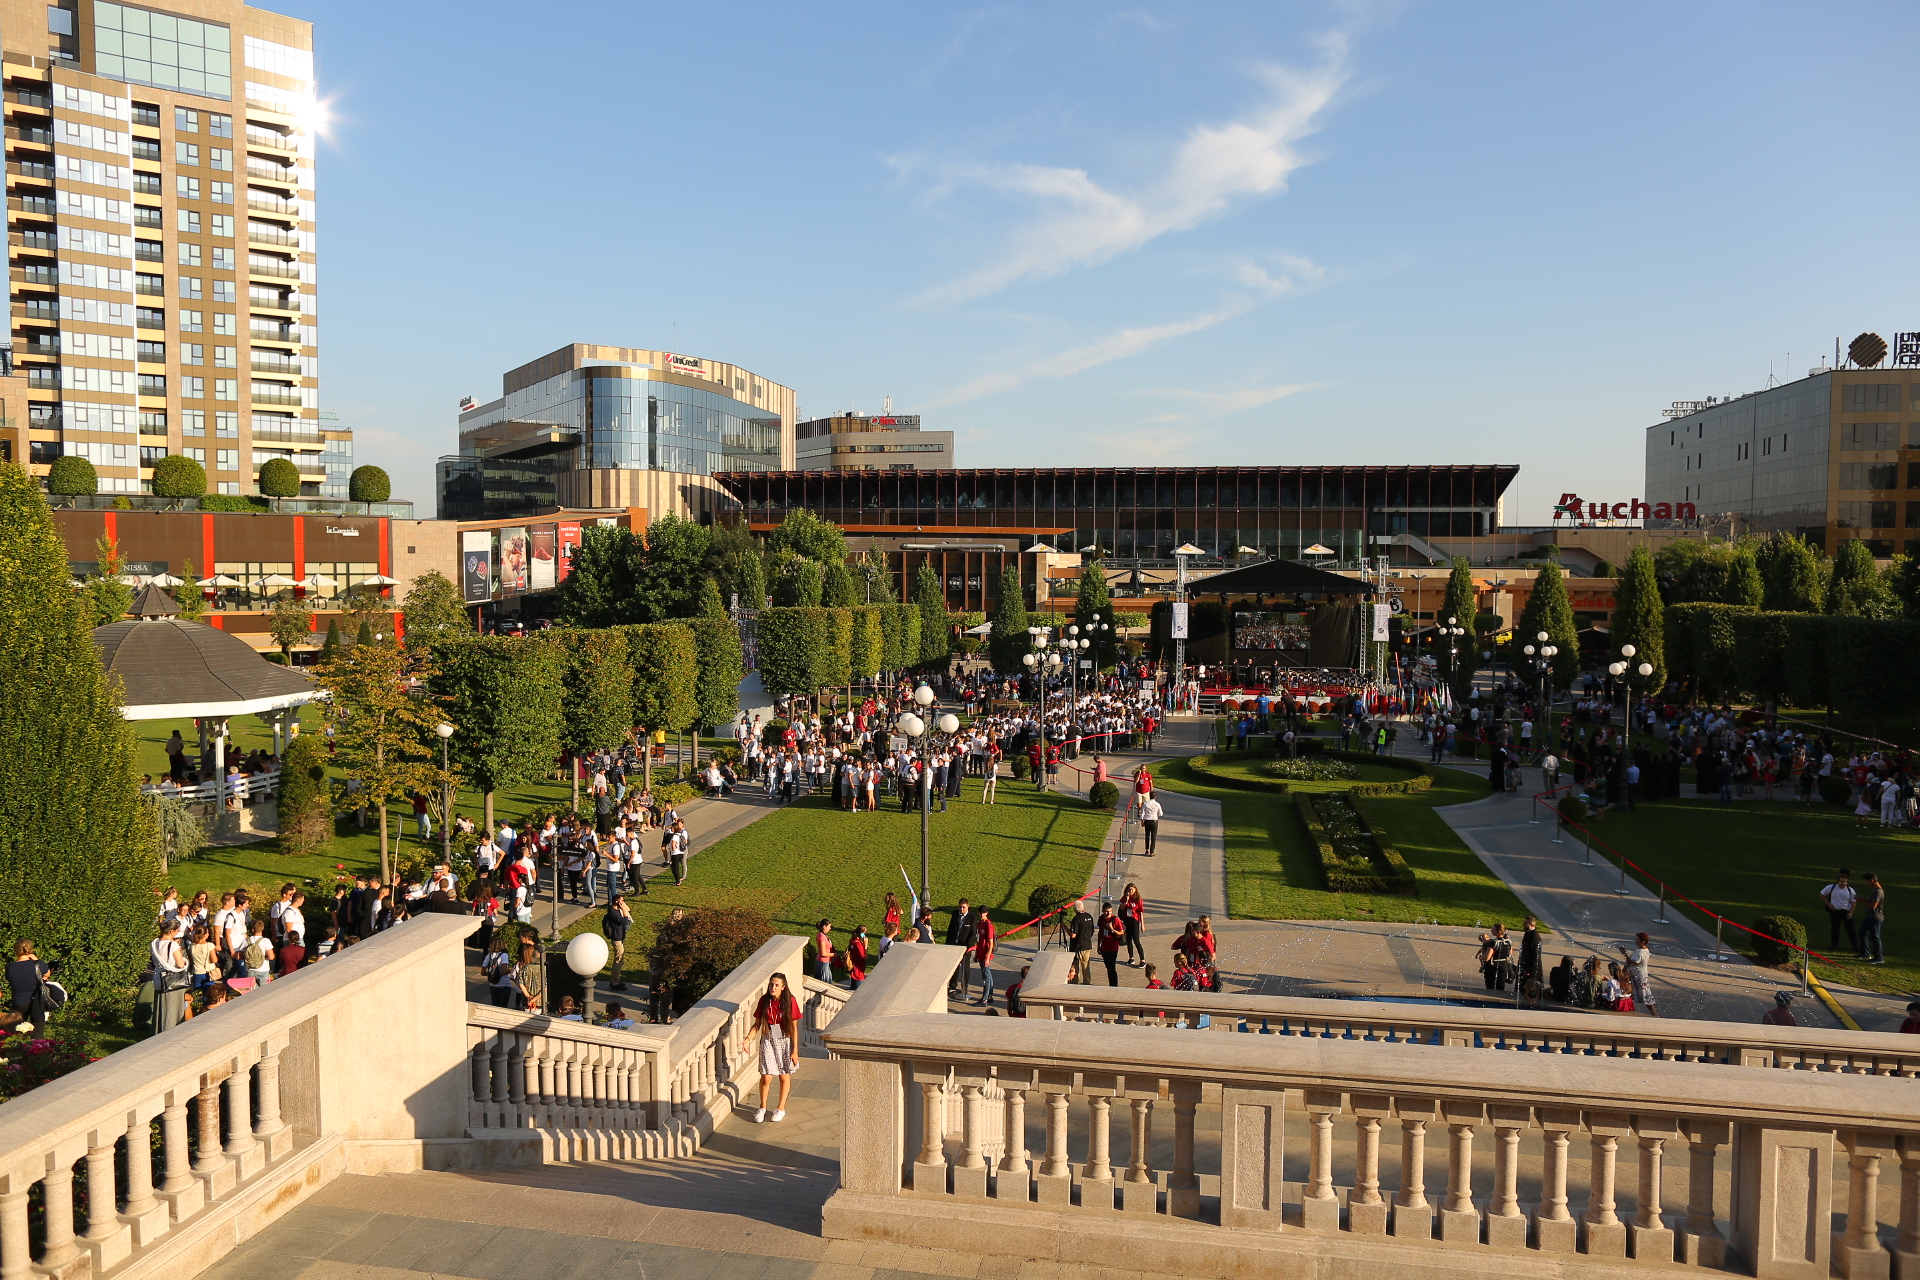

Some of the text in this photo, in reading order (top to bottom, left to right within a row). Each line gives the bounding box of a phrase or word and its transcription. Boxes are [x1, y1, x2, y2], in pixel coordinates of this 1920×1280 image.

[1900, 343, 1920, 354] BU
[1553, 493, 1696, 519] Auchan
[123, 564, 148, 572] NISSA
